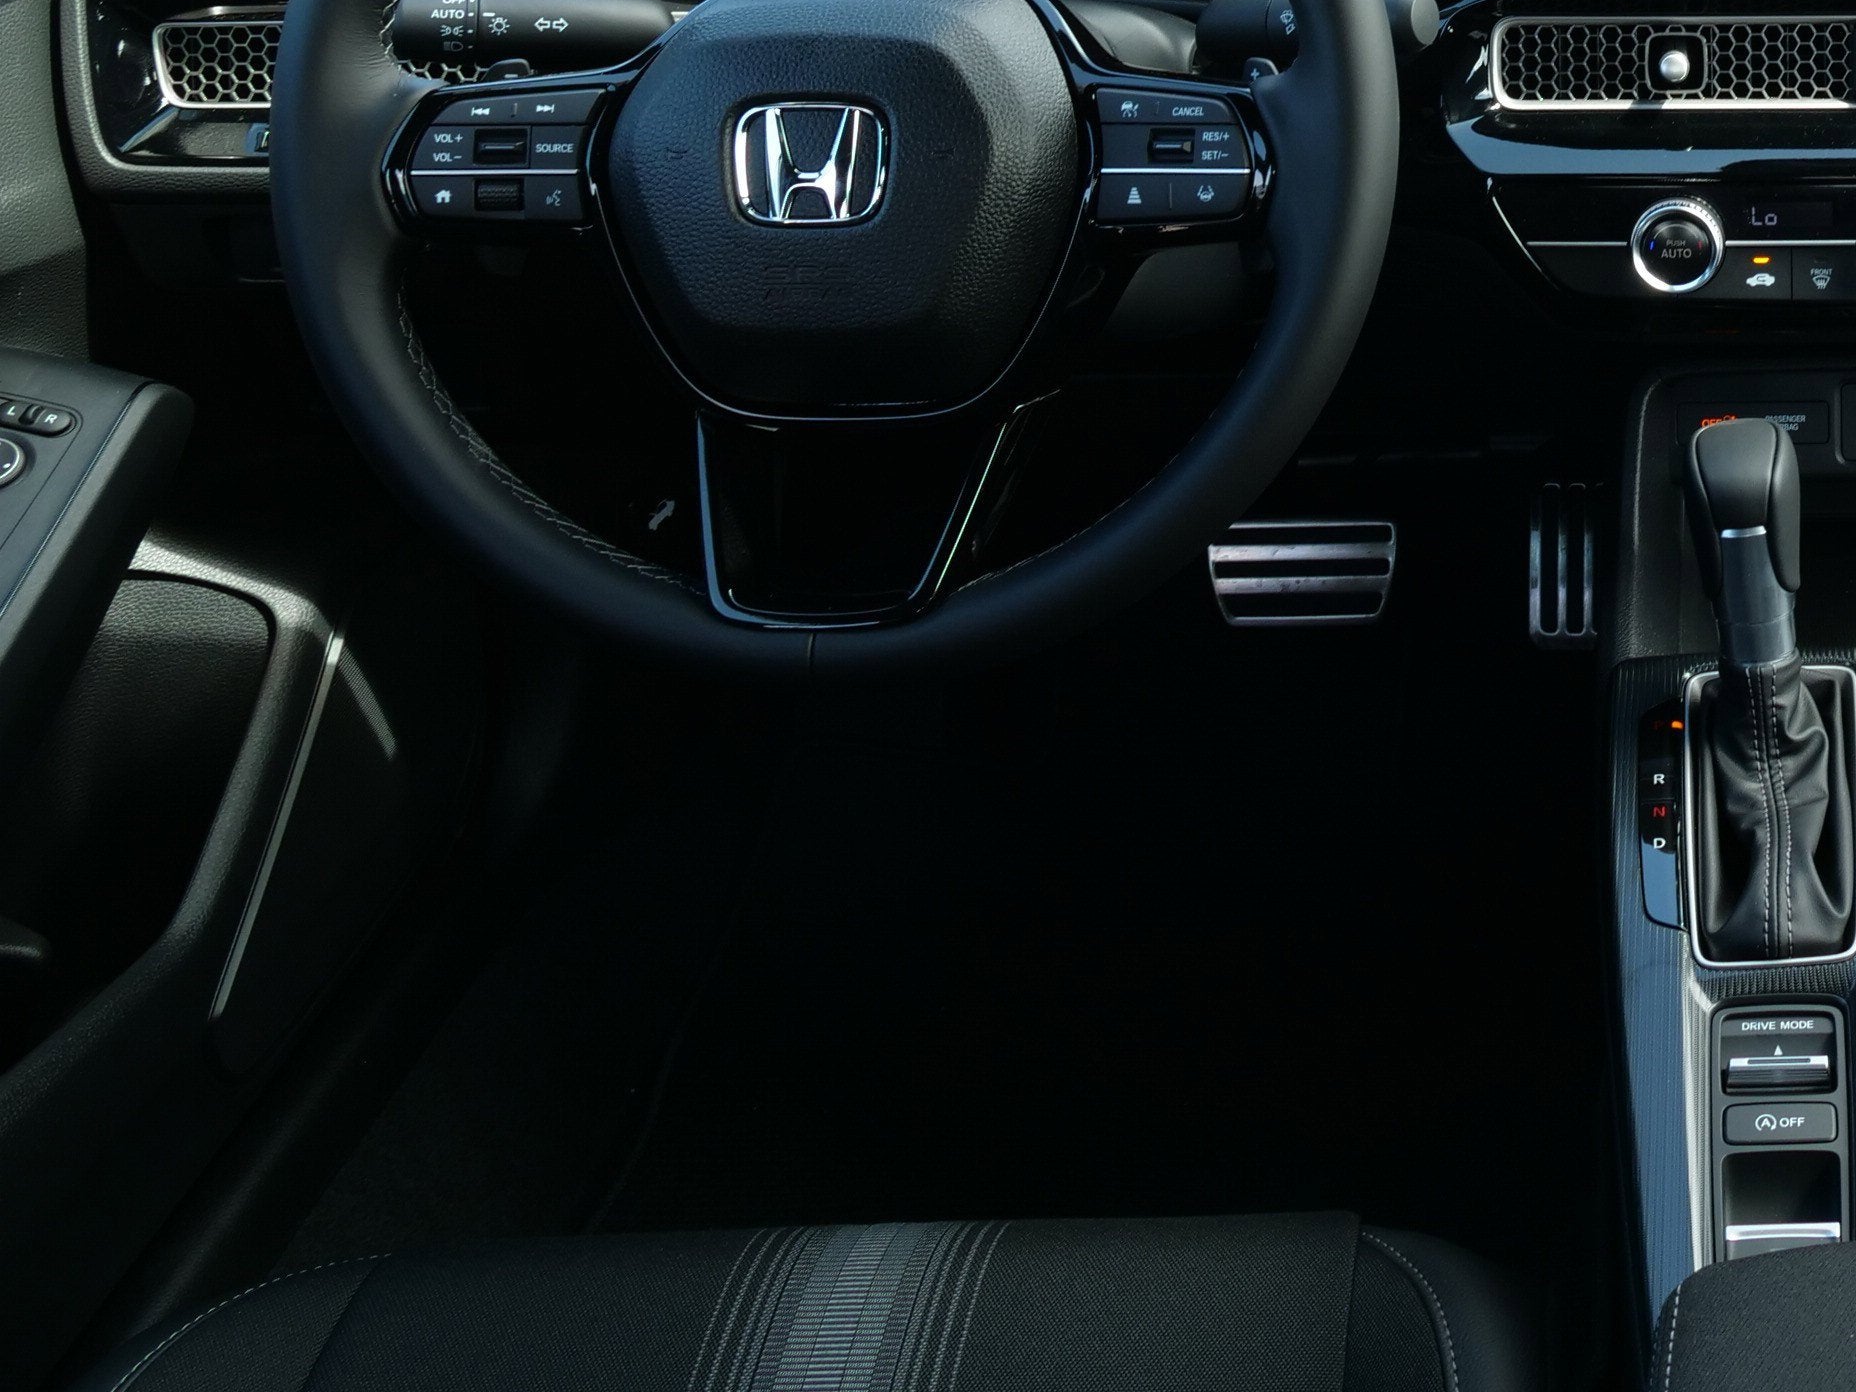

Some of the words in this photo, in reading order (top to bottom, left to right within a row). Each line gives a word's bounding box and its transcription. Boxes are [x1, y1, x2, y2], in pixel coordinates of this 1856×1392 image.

[431, 9, 465, 19] AUTO
[1172, 106, 1205, 117] CANCEL
[535, 143, 575, 154] SOURCE
[1660, 248, 1692, 259] AUTO
[1810, 268, 1833, 276] FRONT
[6, 405, 16, 416] L
[43, 413, 58, 424] R
[1653, 773, 1666, 786] R
[1653, 806, 1666, 818] N
[1653, 837, 1667, 849] D
[1741, 1021, 1776, 1031] DRIVE
[1780, 1020, 1815, 1030] MODE
[1779, 1117, 1806, 1128] OFF
